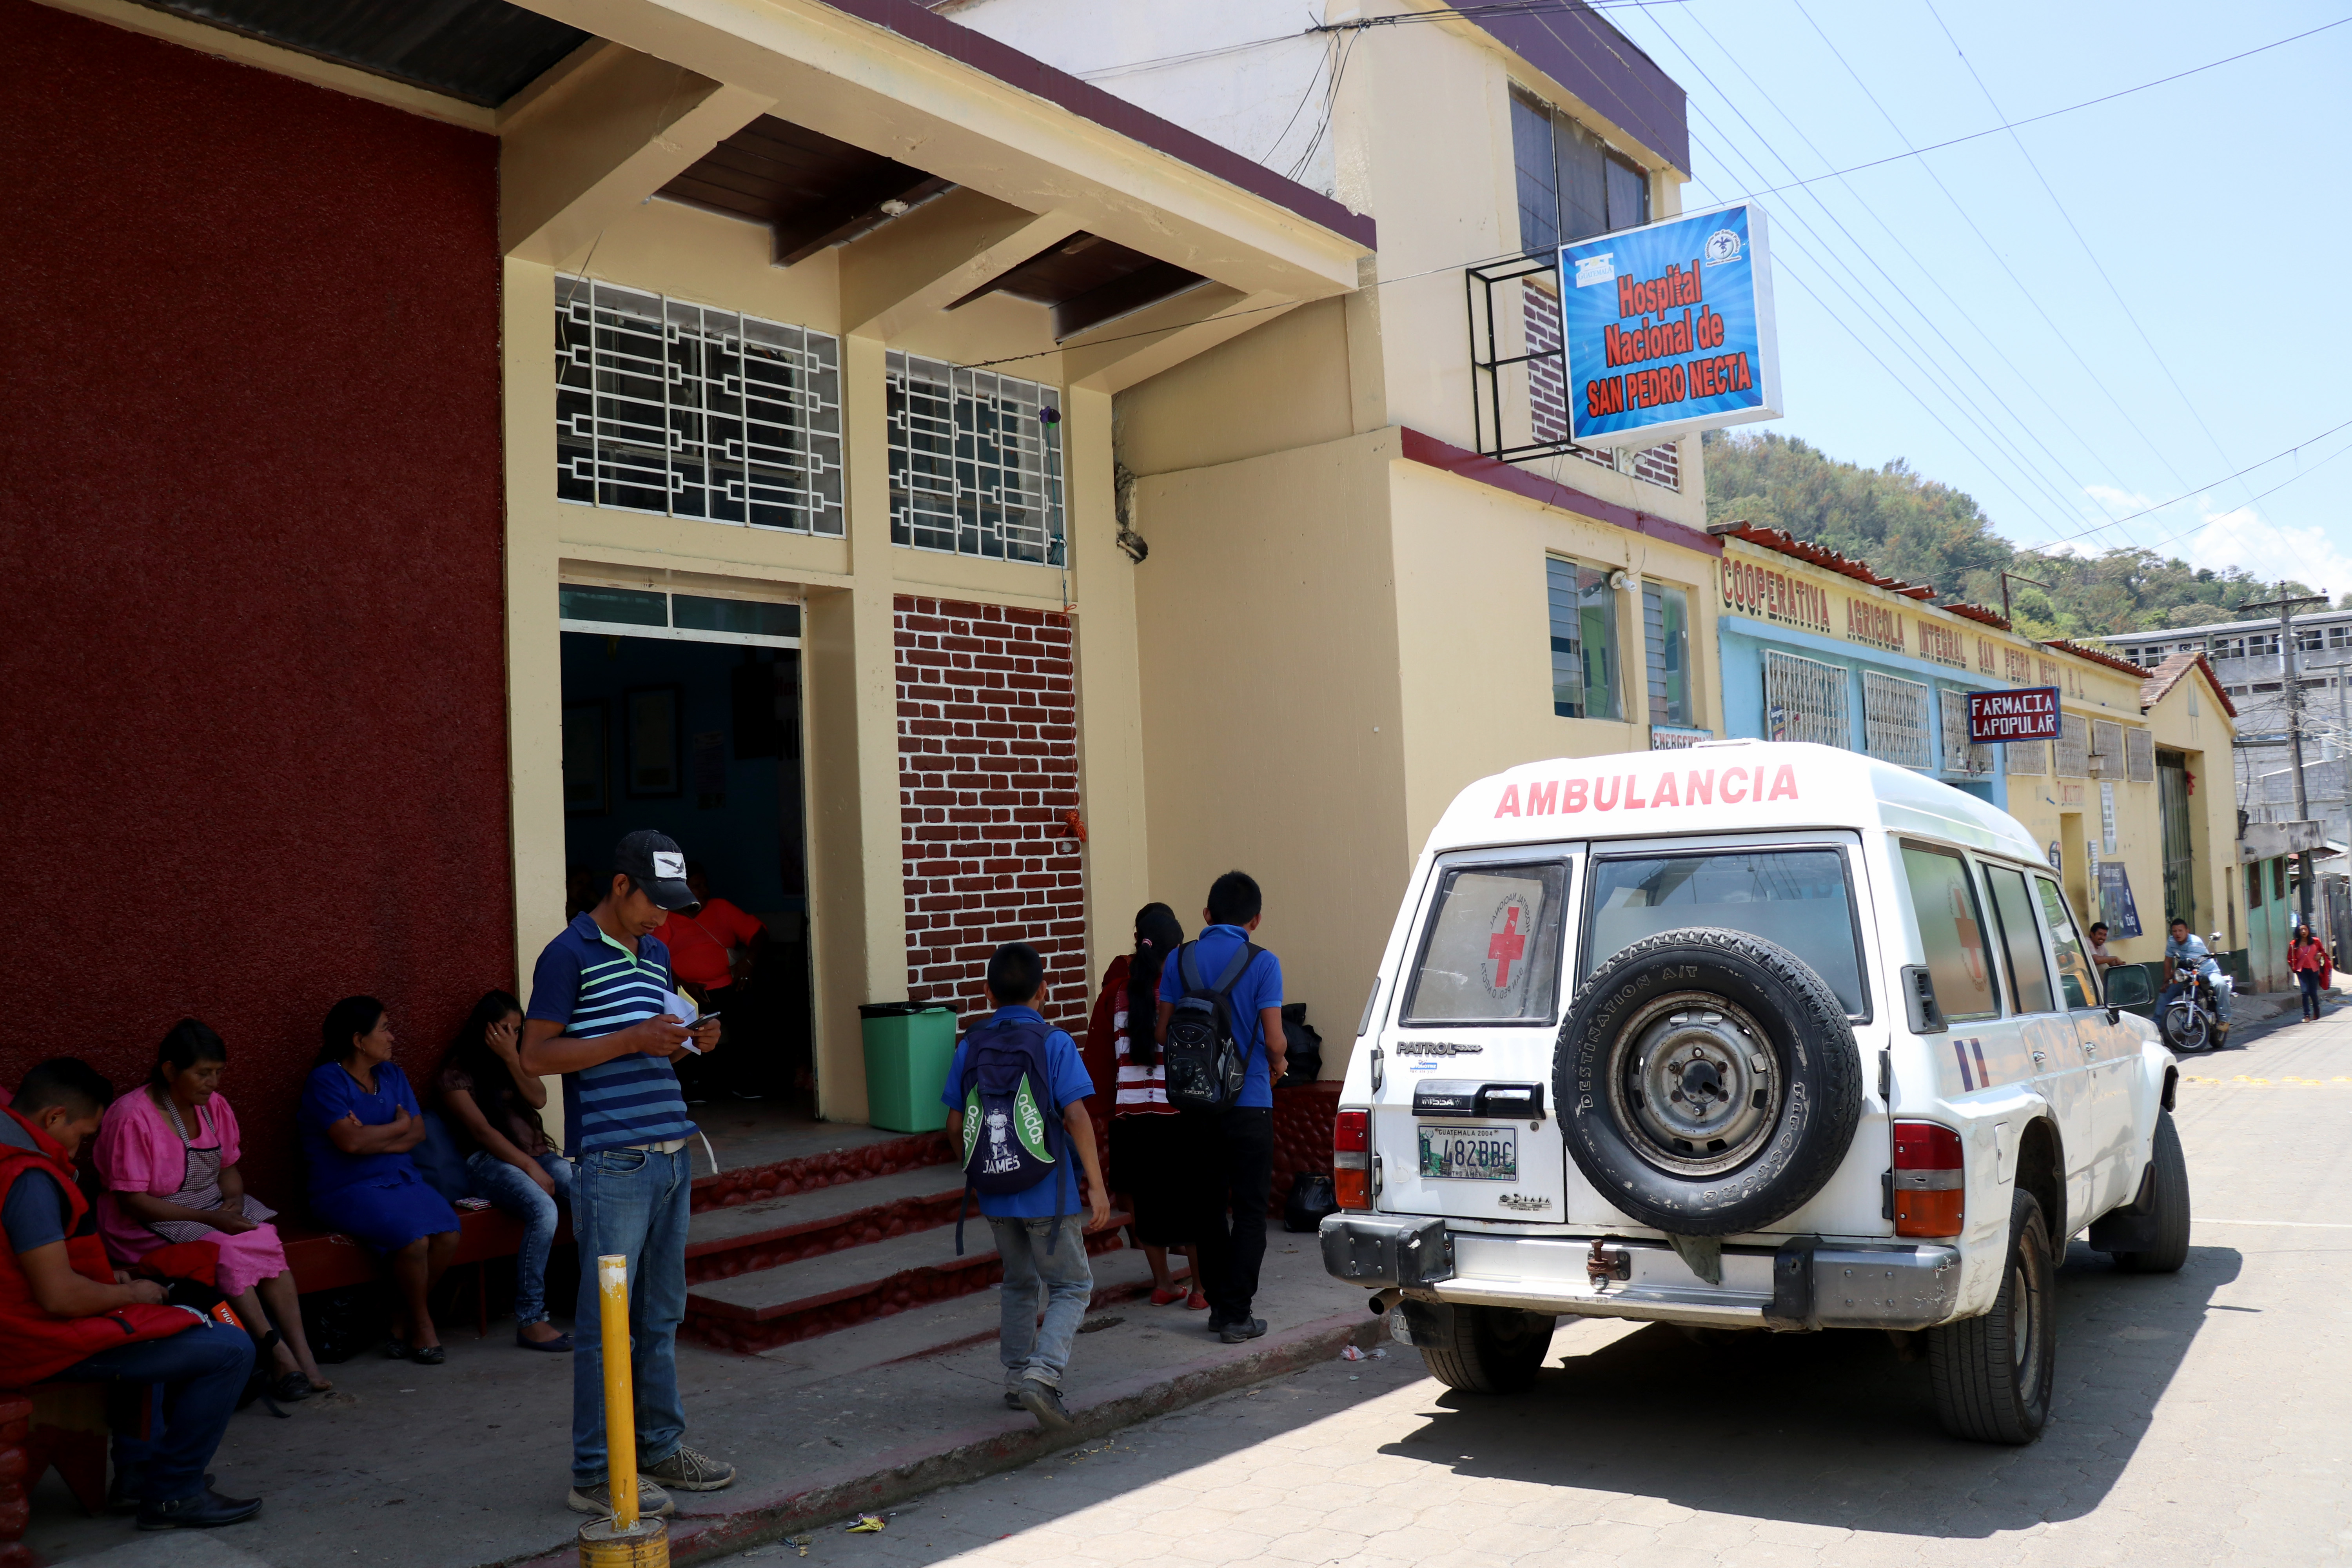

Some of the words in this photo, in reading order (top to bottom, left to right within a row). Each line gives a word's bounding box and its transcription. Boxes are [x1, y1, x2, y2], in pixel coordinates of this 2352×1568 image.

[1578, 266, 1613, 280] GUATEMALA
[1617, 259, 1702, 321] Hospital
[1604, 309, 1693, 368] Nacional
[1696, 304, 1724, 350] de
[1586, 375, 1625, 418] SAN
[1625, 363, 1686, 411] PEDRO
[1687, 352, 1753, 399] NECTA
[1720, 557, 1830, 633] COOPERATIVA
[1847, 597, 1905, 653] AGRICOLA
[1918, 620, 1967, 669] INTEGRAL
[1978, 637, 1995, 676] SAN
[2004, 647, 2031, 685] PEDRO
[2038, 658, 2062, 693] NECTA
[1972, 695, 2053, 716] FARMACIA
[1653, 733, 1706, 750] EMERGEN
[1494, 764, 1799, 818] AMBULANCIA
[1396, 1041, 1456, 1055] PATROL
[1579, 974, 1651, 1109] DESTINATION
[1662, 965, 1698, 980] A/T
[1018, 1093, 1044, 1145] adidas
[1422, 1097, 1462, 1107] NISSAN
[982, 1154, 1021, 1174] JAMES
[1443, 1139, 1513, 1168] 482BBC
